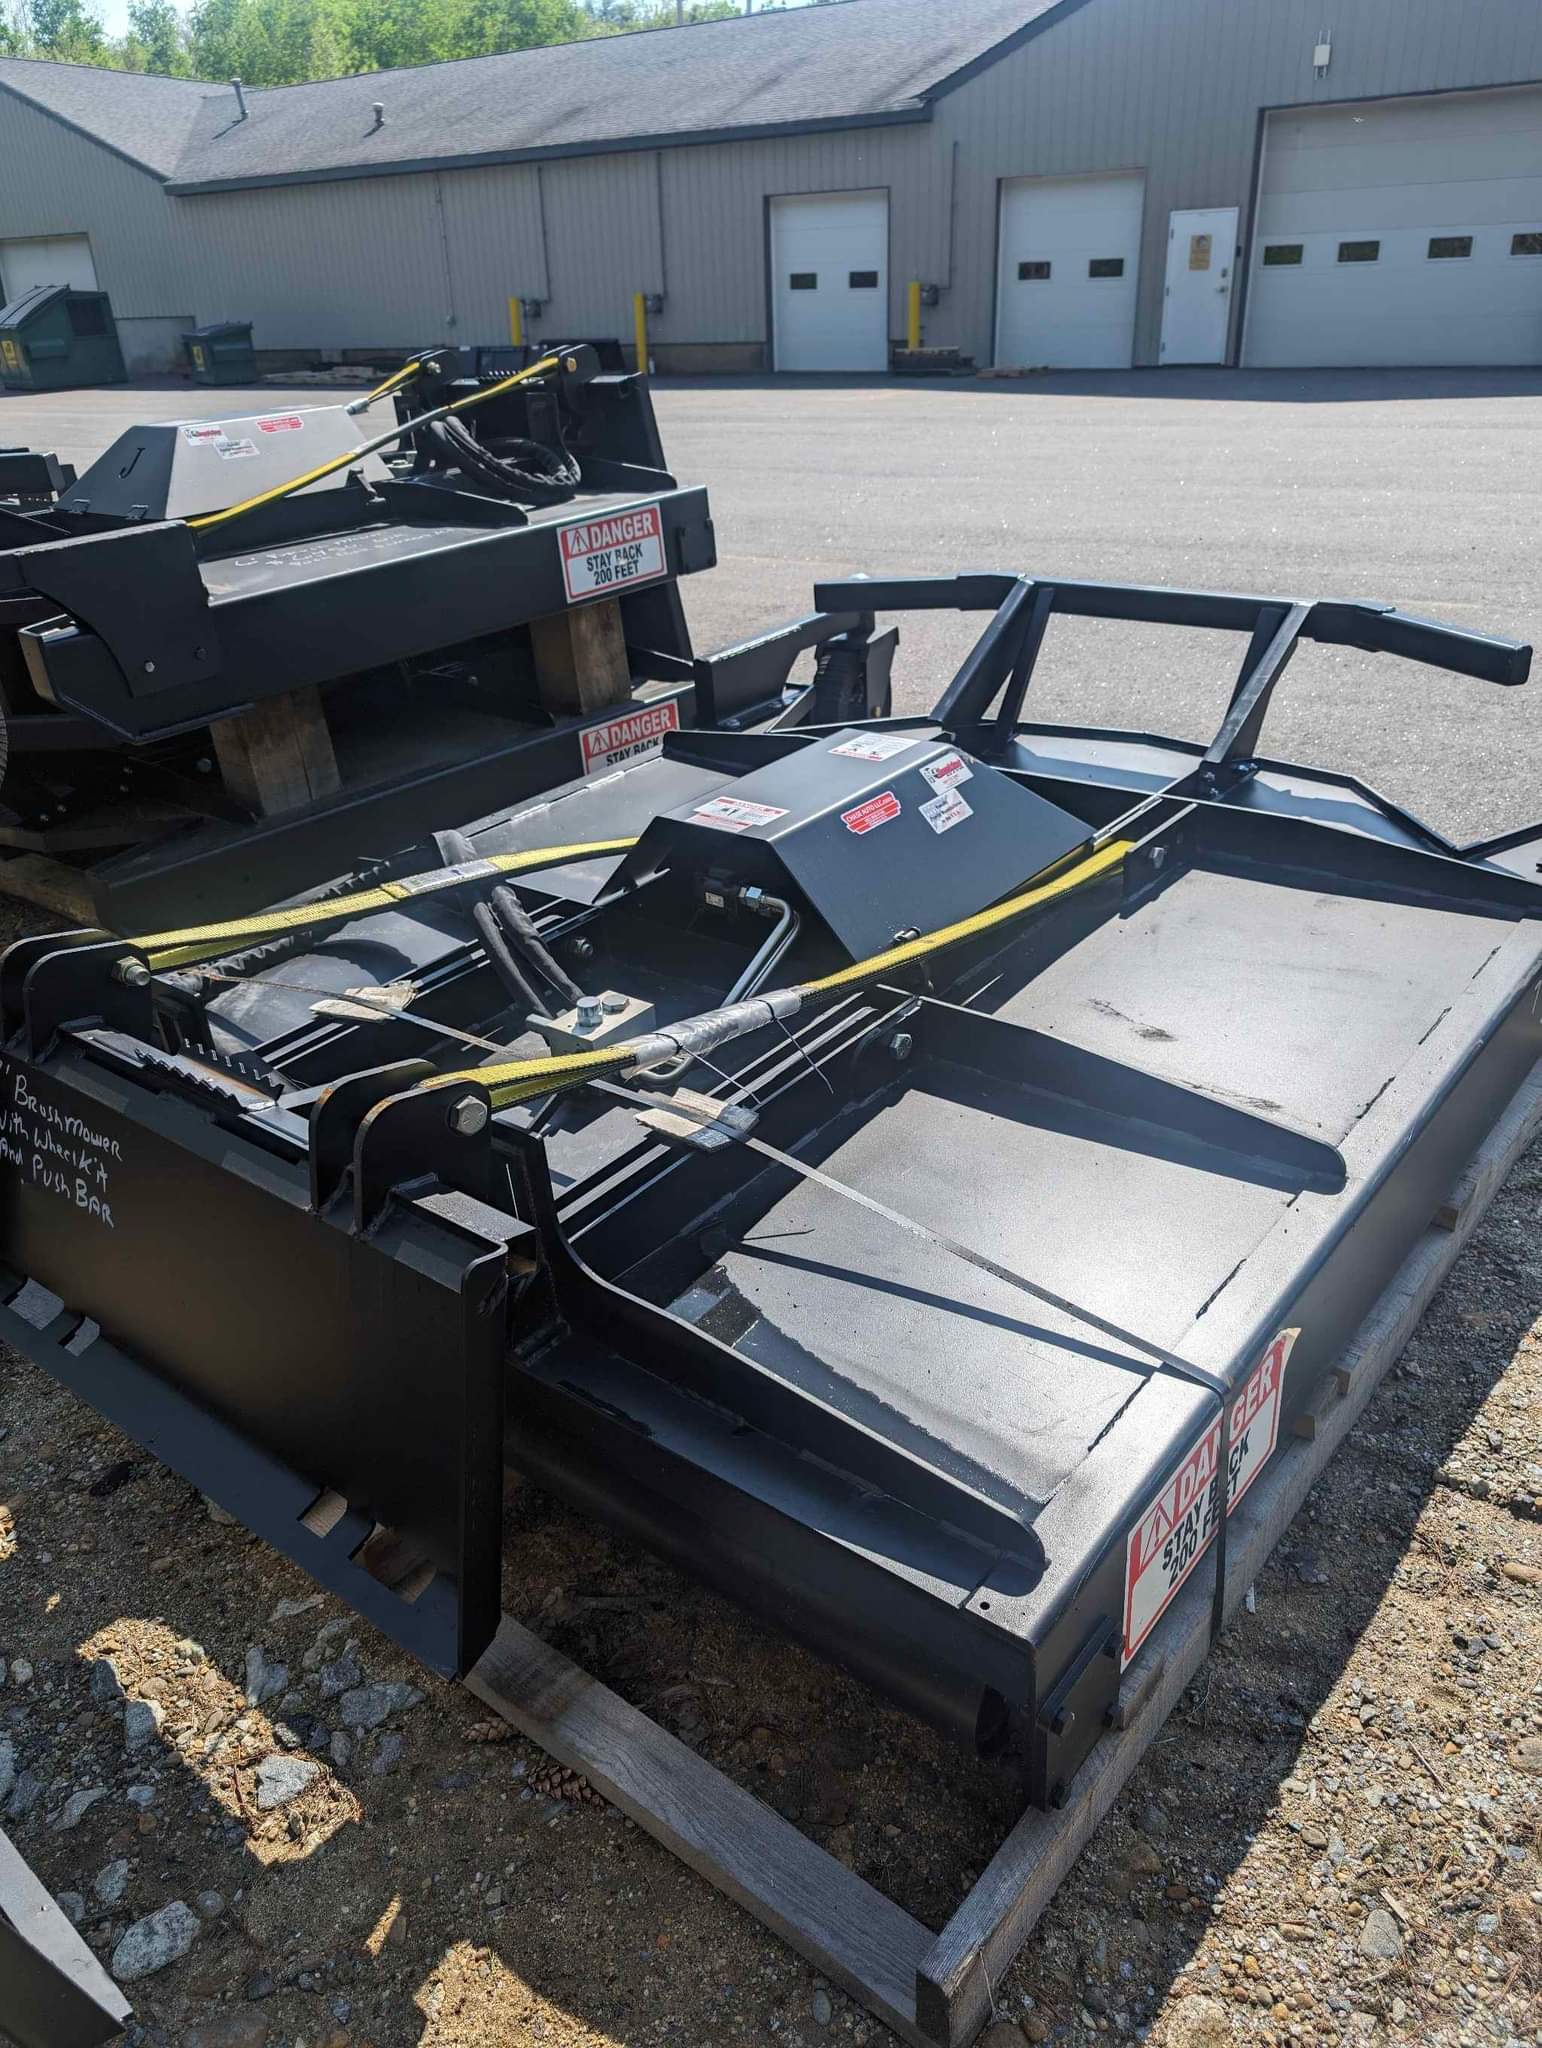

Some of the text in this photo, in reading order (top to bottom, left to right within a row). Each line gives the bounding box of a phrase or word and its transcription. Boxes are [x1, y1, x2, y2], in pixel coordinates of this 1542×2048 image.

[590, 512, 654, 549] DANGER
[586, 551, 613, 572] STAY
[594, 560, 639, 585] 200 FEET
[610, 708, 671, 746] DANGER
[606, 736, 660, 766] STAY BACK
[75, 1178, 114, 1228] BAR
[1162, 1427, 1251, 1570] STAY BCK
[1168, 1464, 1241, 1589] 200 FET
